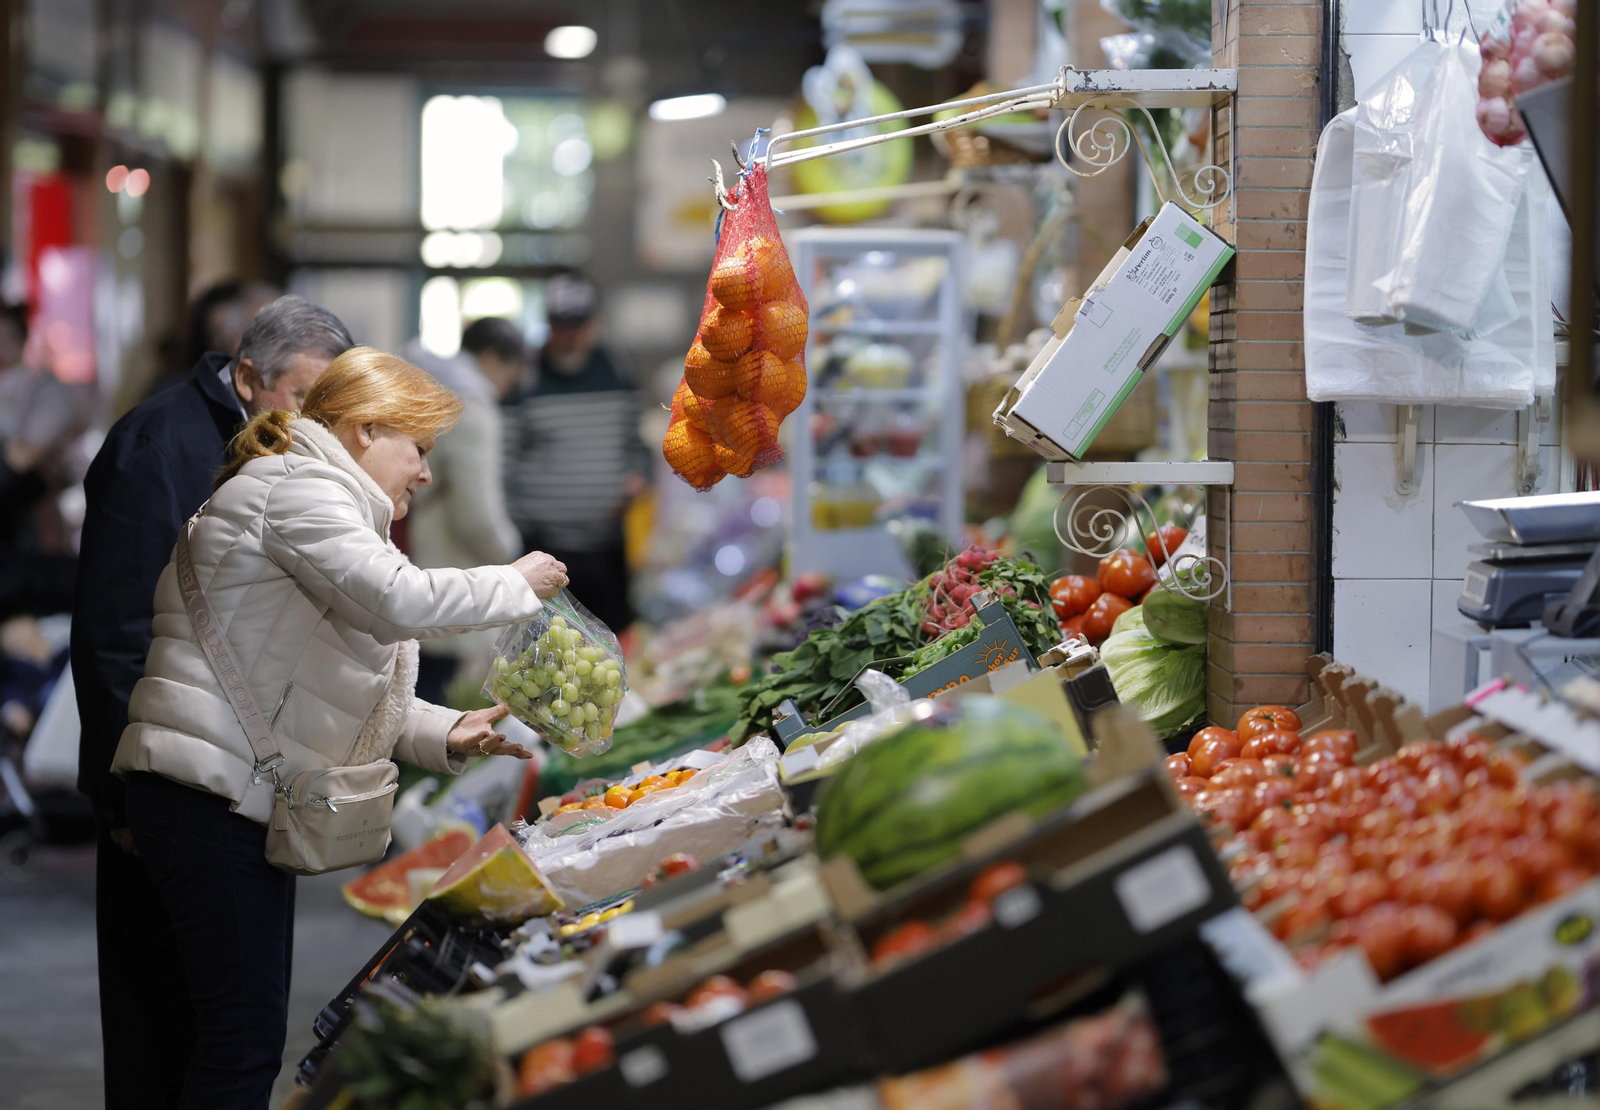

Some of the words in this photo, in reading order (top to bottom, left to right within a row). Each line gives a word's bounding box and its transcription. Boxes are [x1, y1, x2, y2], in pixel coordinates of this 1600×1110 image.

[195, 608, 258, 726] ROBERTO
[987, 652, 1004, 673] bor
[337, 831, 366, 841] ROBERTO
